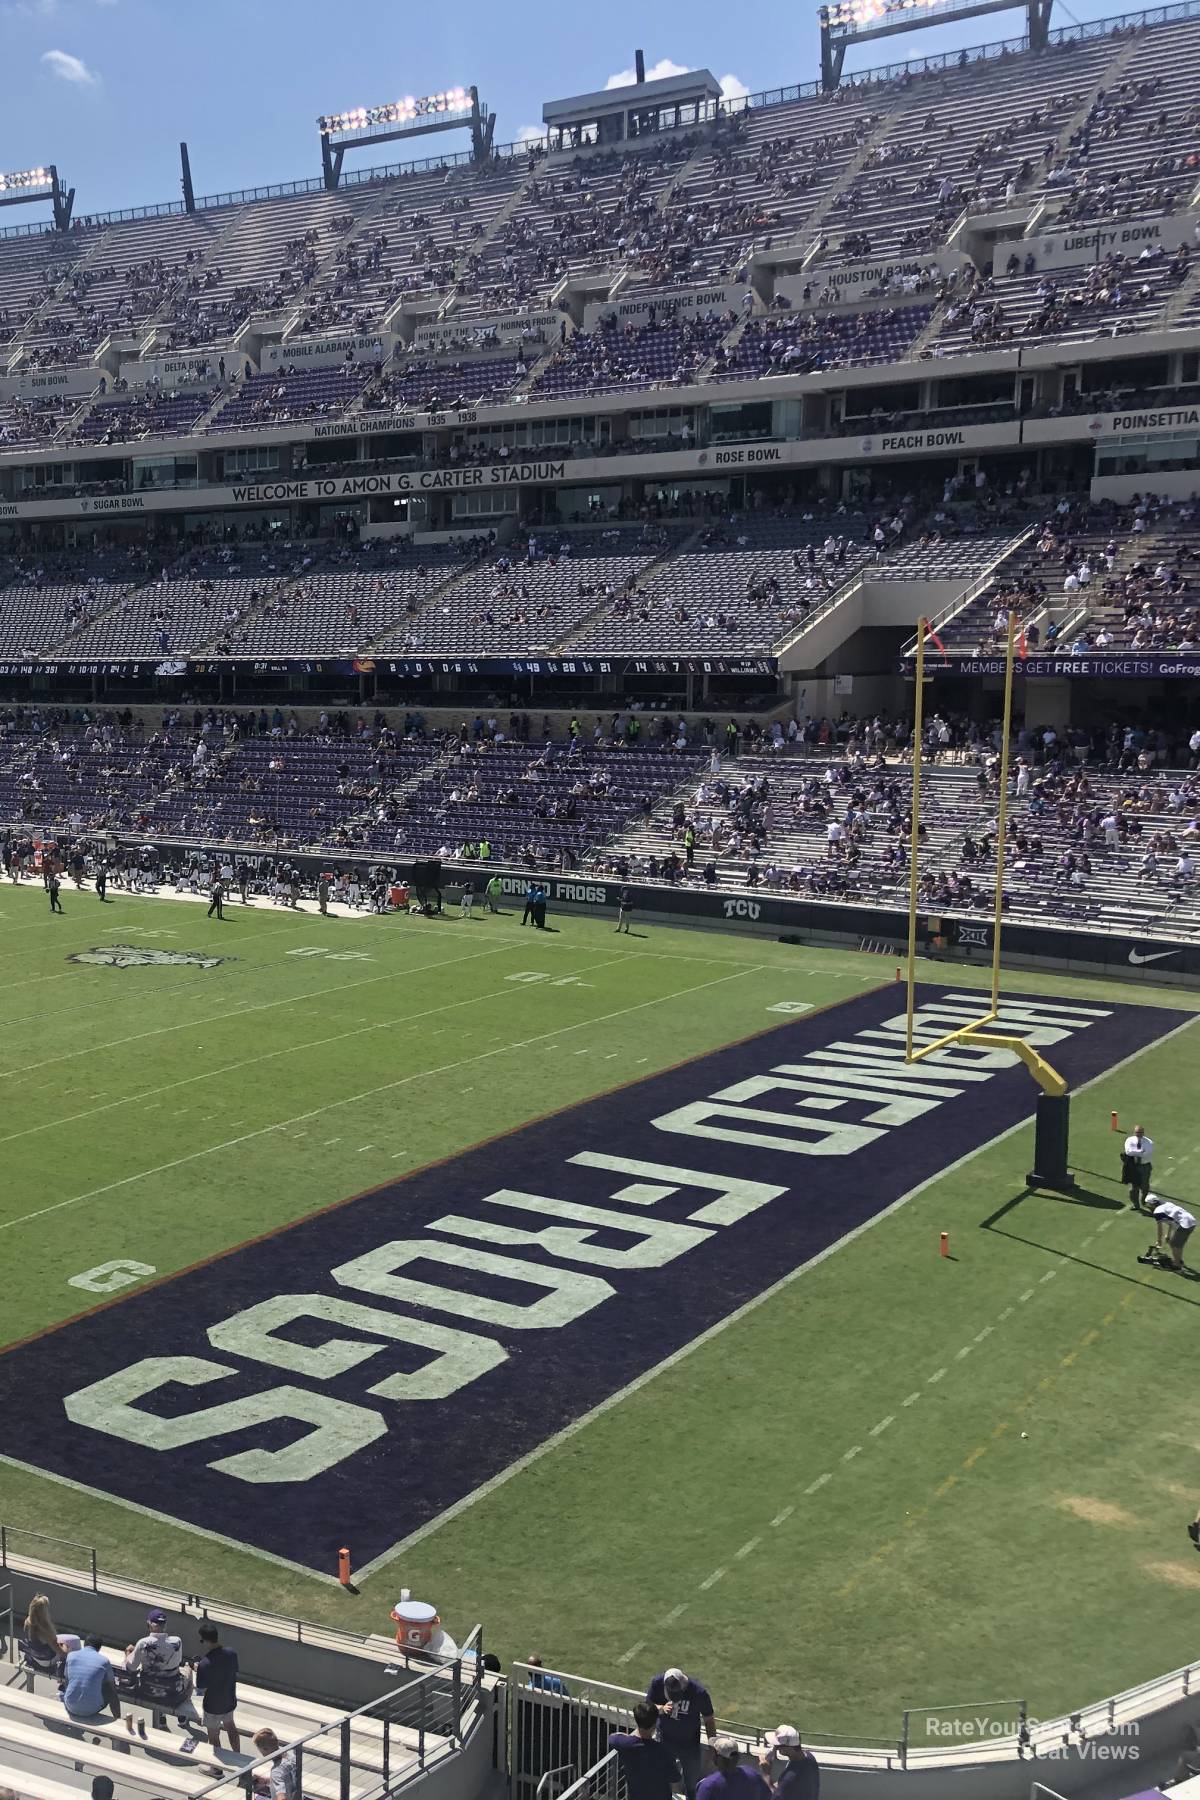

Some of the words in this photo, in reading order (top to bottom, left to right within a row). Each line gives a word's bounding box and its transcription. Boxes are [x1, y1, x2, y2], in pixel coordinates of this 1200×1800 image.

[1063, 231, 1117, 251] LIBERTY
[1121, 225, 1162, 243] BOWL
[828, 268, 883, 286] HOUSTON
[885, 264, 919, 280] BOW
[619, 295, 694, 316] INDEPNDENCE
[696, 292, 727, 306] BOWL
[418, 330, 441, 342] HOME
[443, 328, 452, 339] OF
[455, 327, 470, 338] THE
[501, 319, 532, 331] HORNED
[532, 315, 557, 326] FROGS
[282, 346, 313, 359] MOBILE
[315, 340, 357, 355] ALABAMA
[359, 337, 384, 349] BOWL
[164, 360, 187, 373] DELTA
[31, 378, 47, 388] SUN
[48, 375, 69, 386] BOWL
[314, 421, 357, 437] NATIONAL
[359, 417, 415, 434] CHAMPIONS
[427, 414, 446, 427] 1935
[457, 411, 477, 424] 1938
[1113, 409, 1199, 430] POINSETTIA
[882, 435, 923, 450] PEACH
[927, 431, 965, 446] BOWL
[716, 451, 744, 465] ROSE
[748, 448, 781, 462] BOWL
[233, 480, 308, 502] WELCOME
[315, 479, 336, 497] TO
[342, 474, 391, 496] AMON
[398, 473, 415, 490] G.
[421, 467, 483, 489] CARTER
[491, 461, 566, 485] STADIUM
[93, 499, 119, 510] SUGAR
[121, 497, 144, 508] BOWL
[44, 666, 58, 674] 351
[526, 662, 541, 673] 49
[562, 662, 576, 673] 28
[600, 662, 612, 673] 21
[635, 662, 648, 673] 14
[673, 662, 679, 672] 7
[703, 662, 711, 672] 0
[1026, 662, 1052, 673] GET
[1055, 661, 1089, 674] FREE
[1093, 662, 1153, 674] TICKETS!
[501, 877, 551, 898] ORND
[556, 883, 607, 904] FROGS
[723, 899, 761, 919] TCU
[503, 971, 590, 987] 10
[650, 993, 1115, 1157] HORNED
[67, 1259, 157, 1293] G
[62, 1150, 792, 1484] FROGS
[408, 1629, 420, 1642] G
